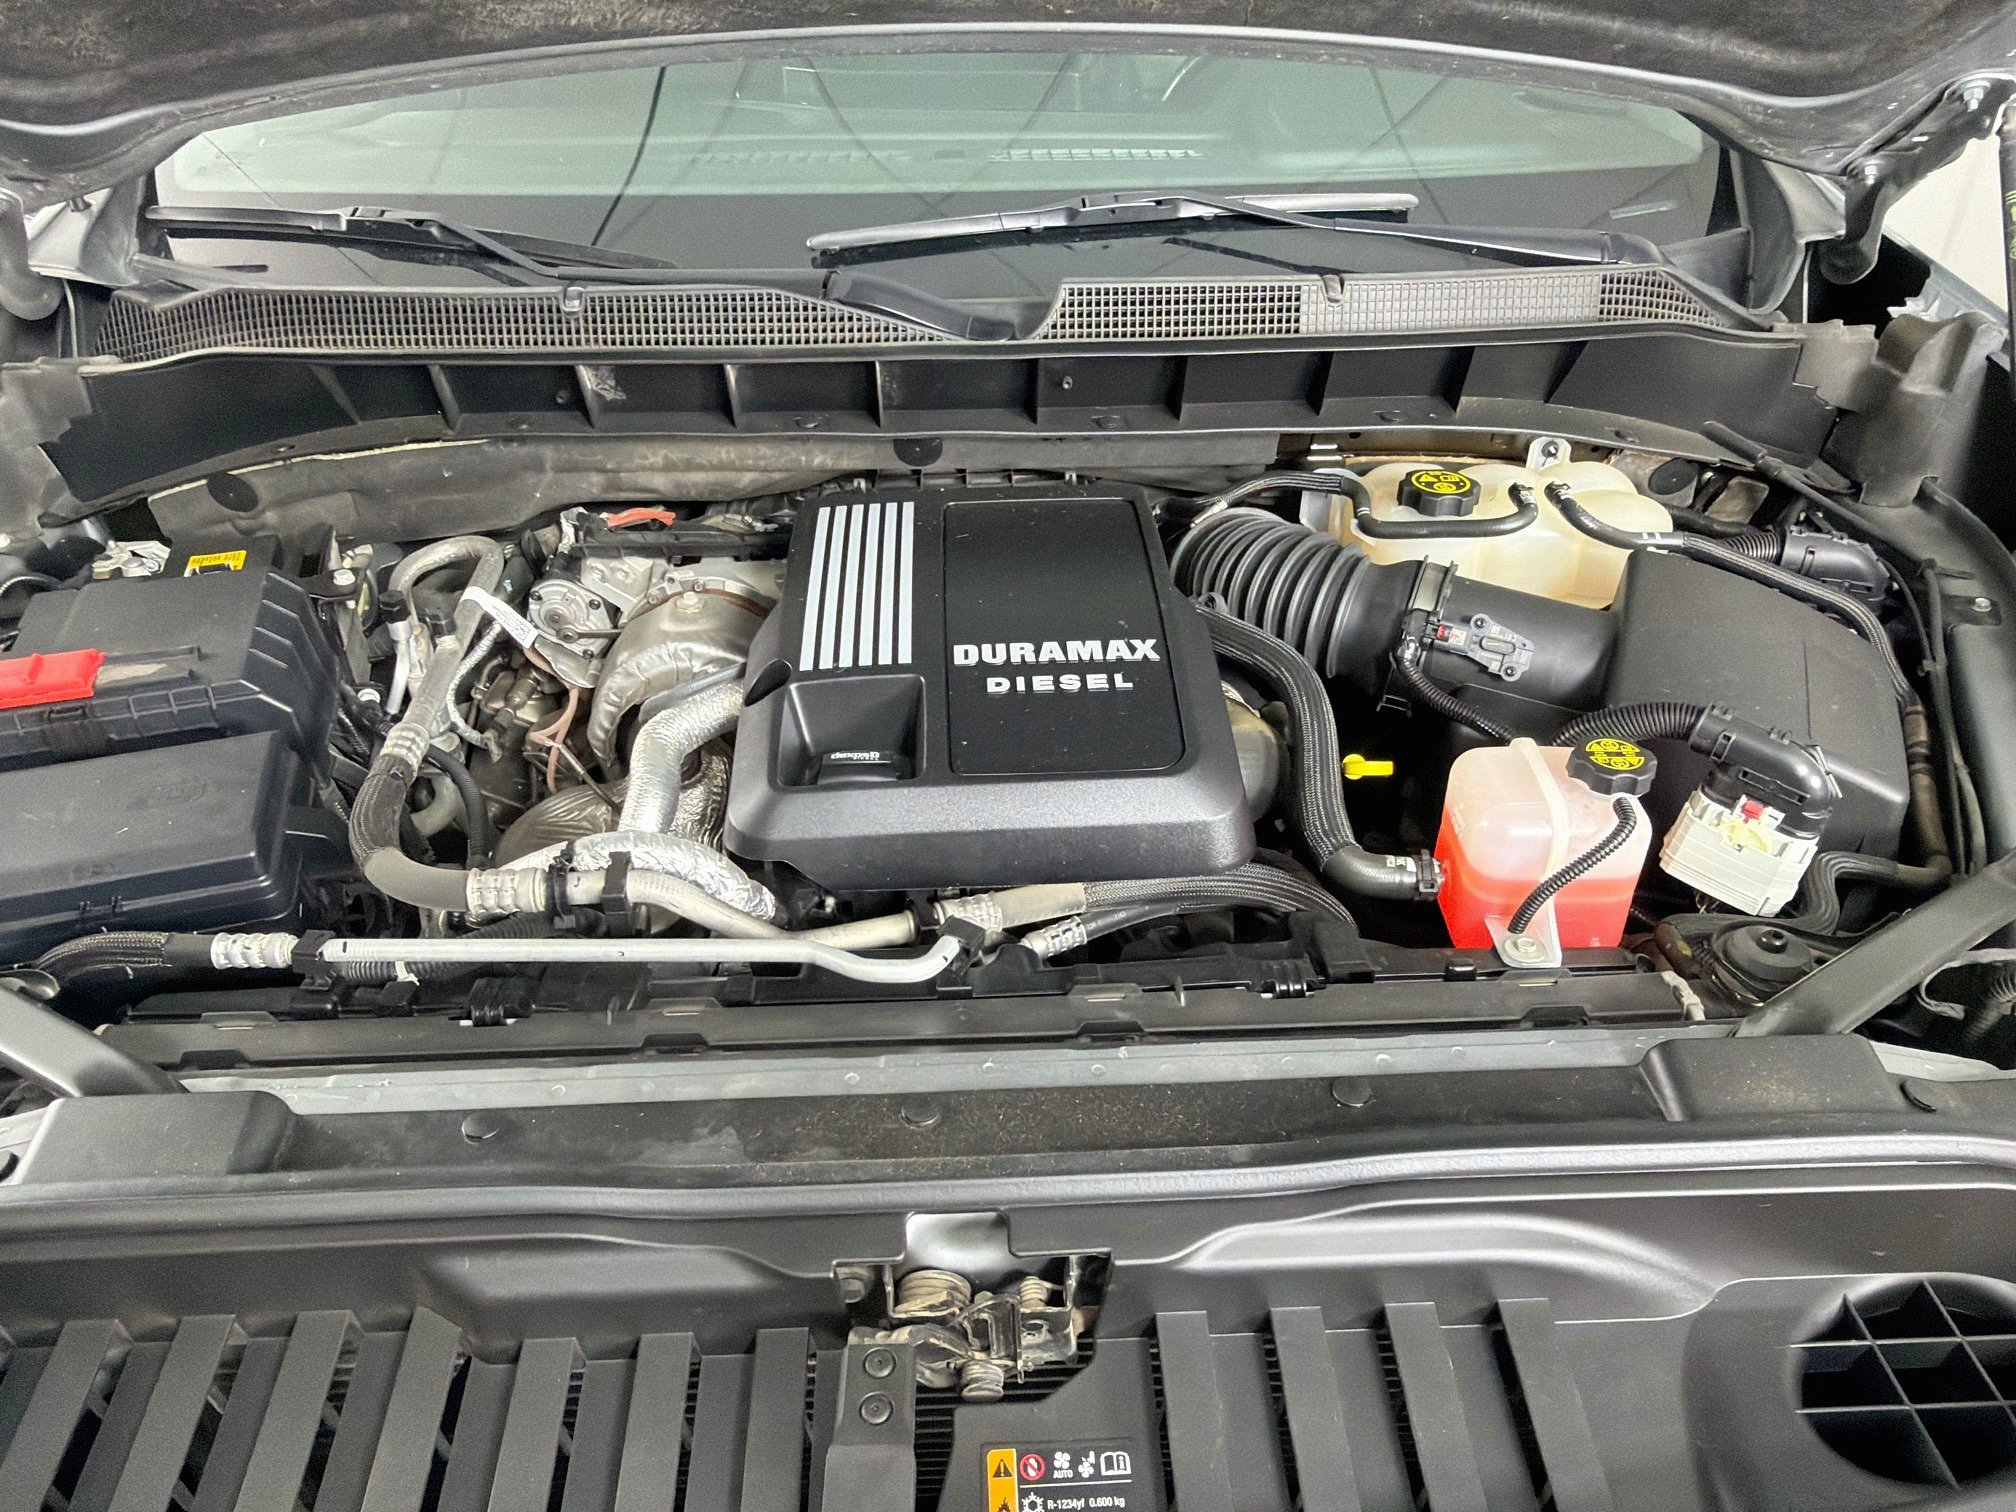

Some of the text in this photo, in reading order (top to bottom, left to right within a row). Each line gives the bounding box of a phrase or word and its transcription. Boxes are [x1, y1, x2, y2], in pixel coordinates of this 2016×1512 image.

[953, 639, 1161, 665] DURAMAX
[986, 674, 1134, 693] DIESEL
[1053, 1469, 1073, 1479] AUTO
[1047, 1496, 1126, 1510] R-1234yf 0.600 kg
